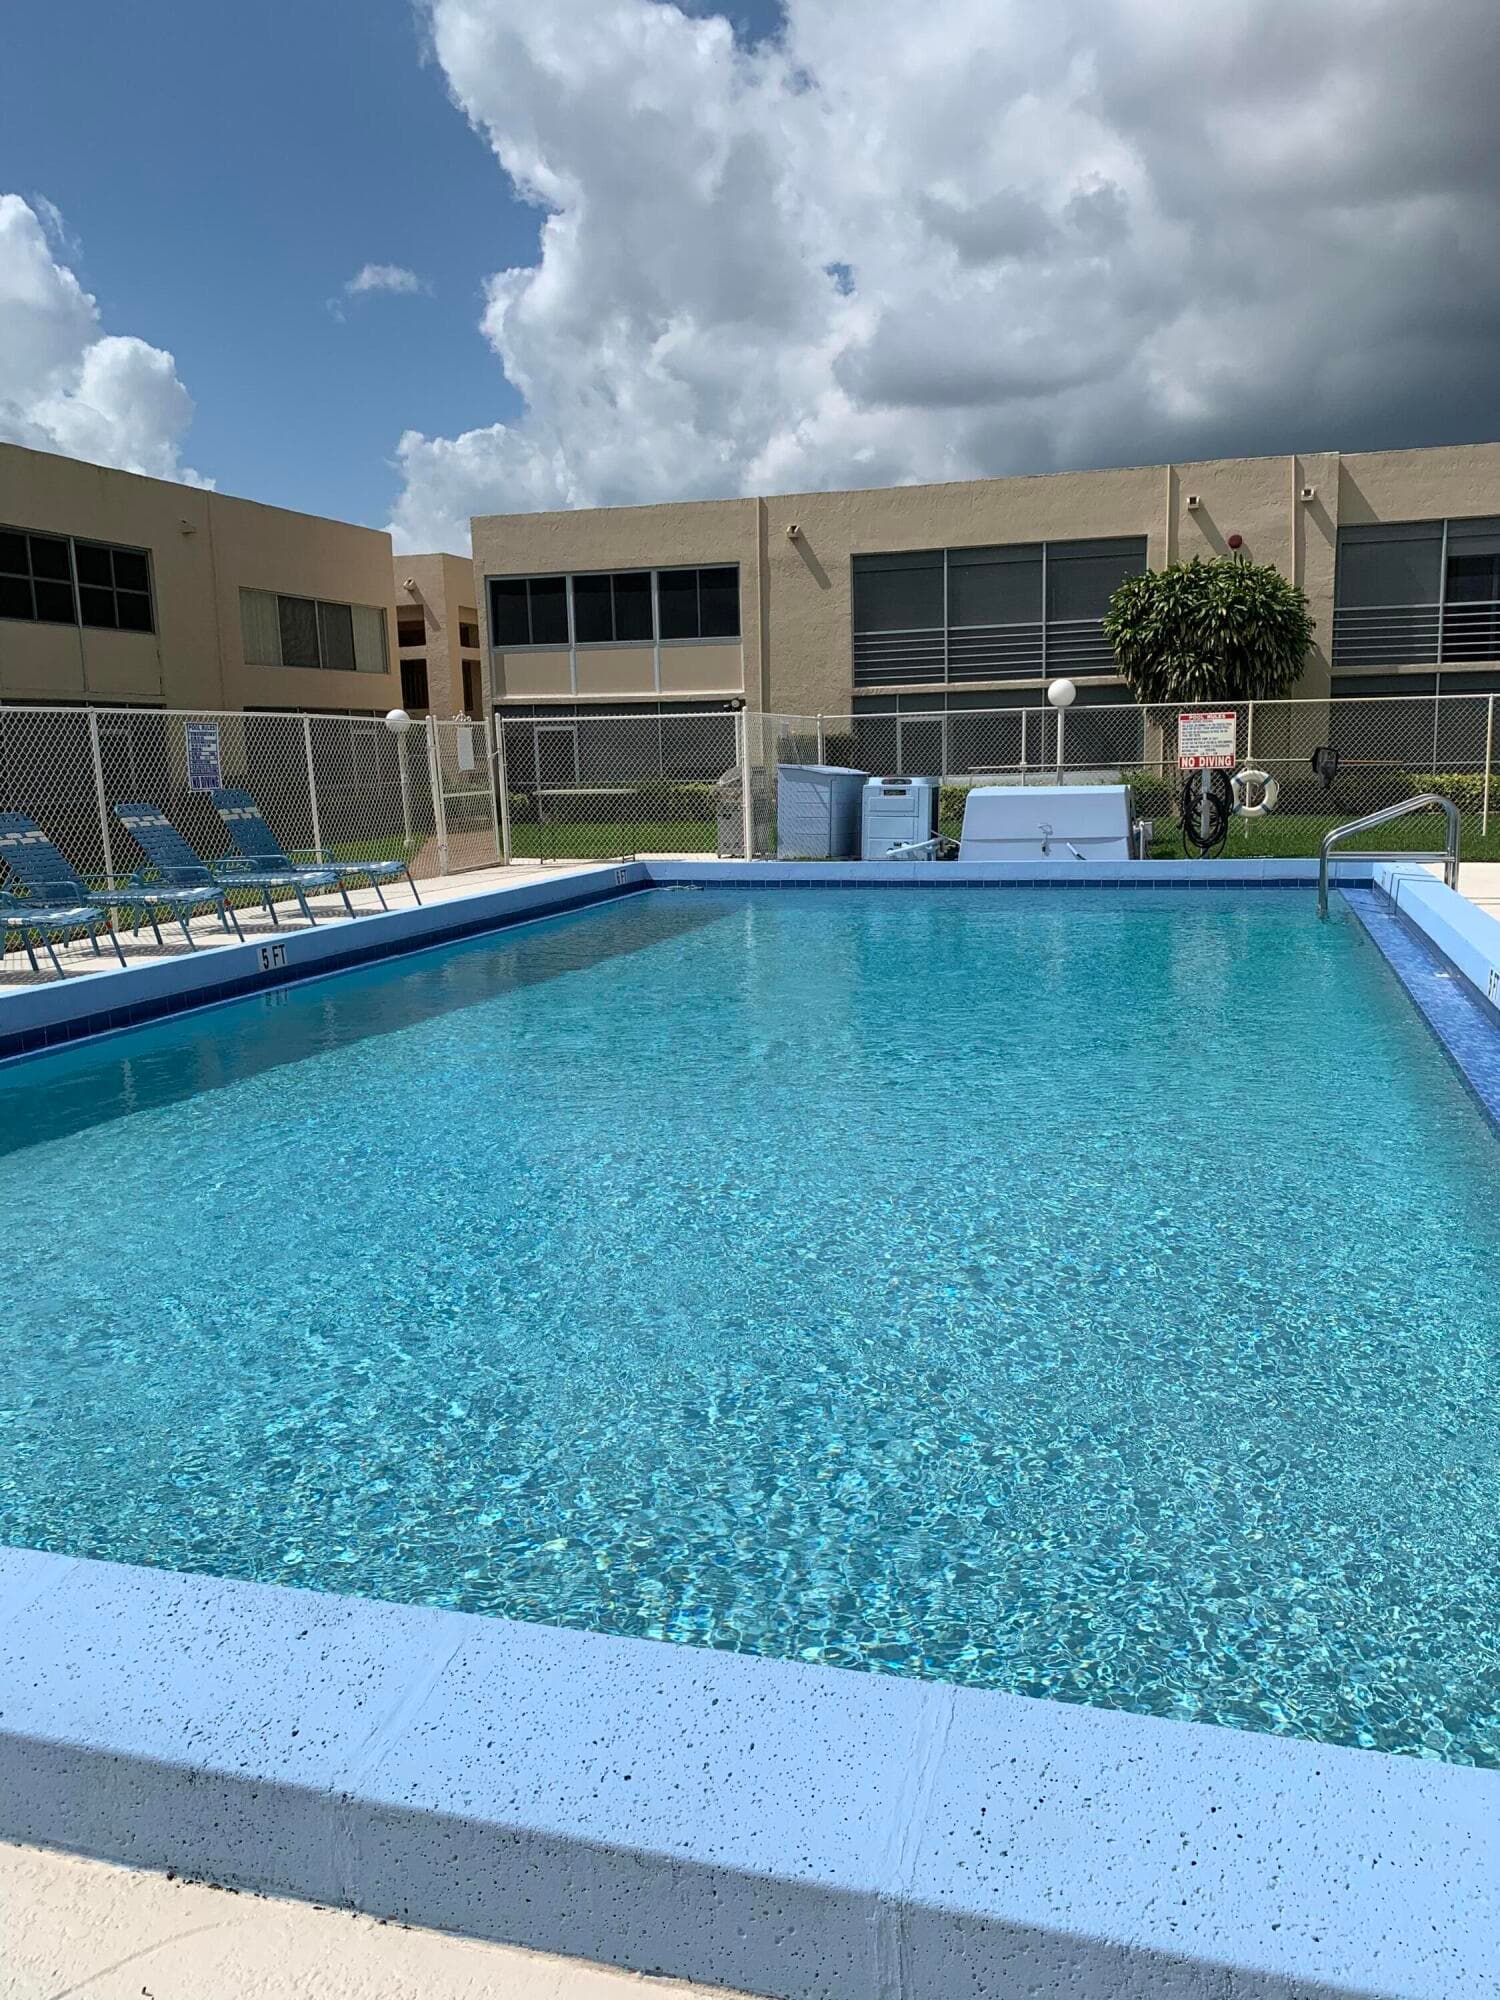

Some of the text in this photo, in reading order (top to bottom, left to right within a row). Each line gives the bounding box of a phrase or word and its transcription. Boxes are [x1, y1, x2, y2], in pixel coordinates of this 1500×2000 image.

[1181, 756, 1232, 767] NO DIVING
[261, 944, 286, 970] 5 FT
